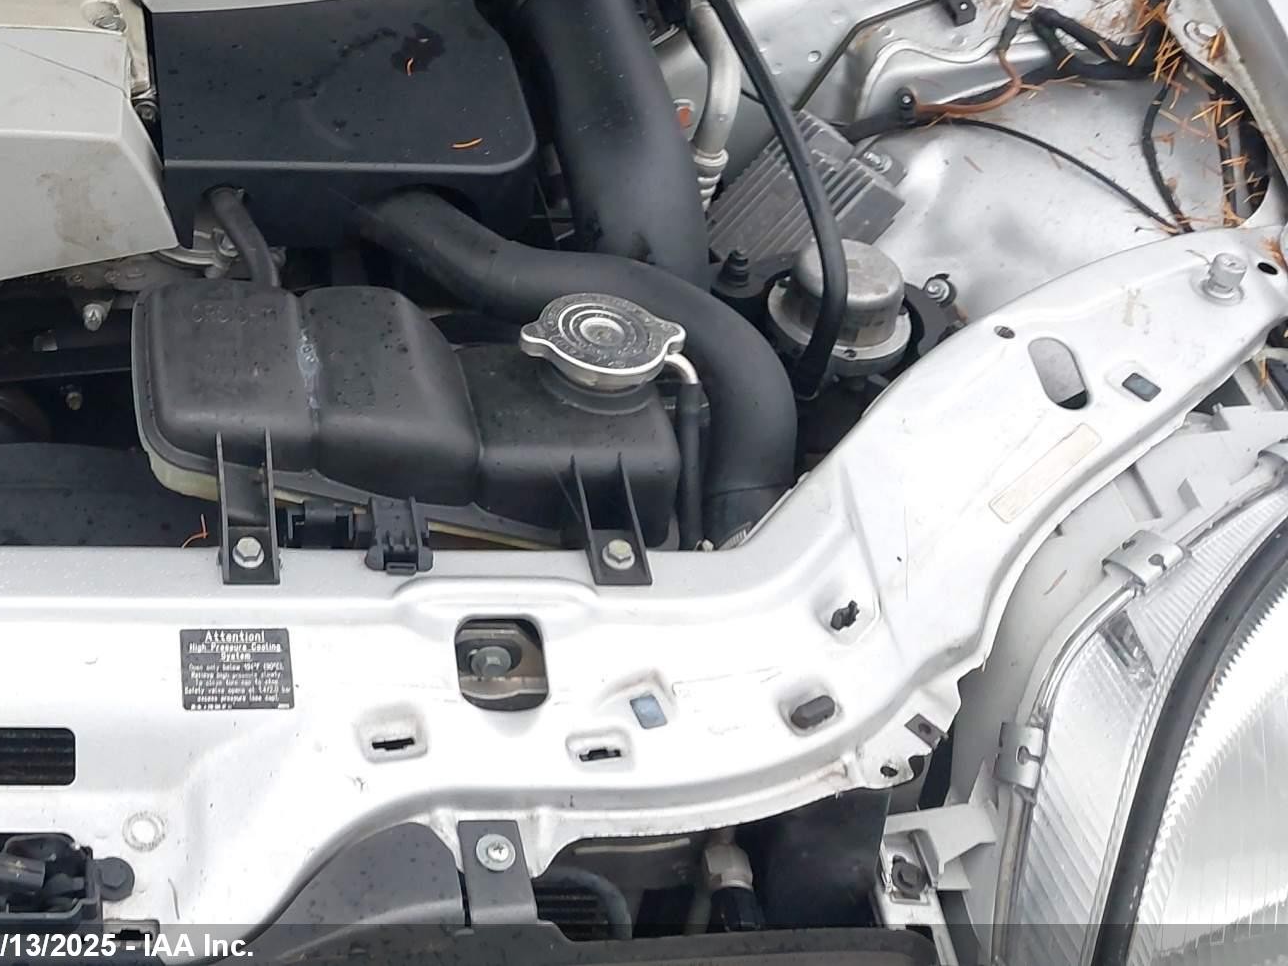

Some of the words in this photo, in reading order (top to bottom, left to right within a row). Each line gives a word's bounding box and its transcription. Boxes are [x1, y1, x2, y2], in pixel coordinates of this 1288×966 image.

[204, 630, 265, 643] Attention!
[189, 642, 207, 652] High
[210, 642, 247, 652] Pressure
[251, 642, 281, 652] Cooling
[220, 652, 251, 661] System
